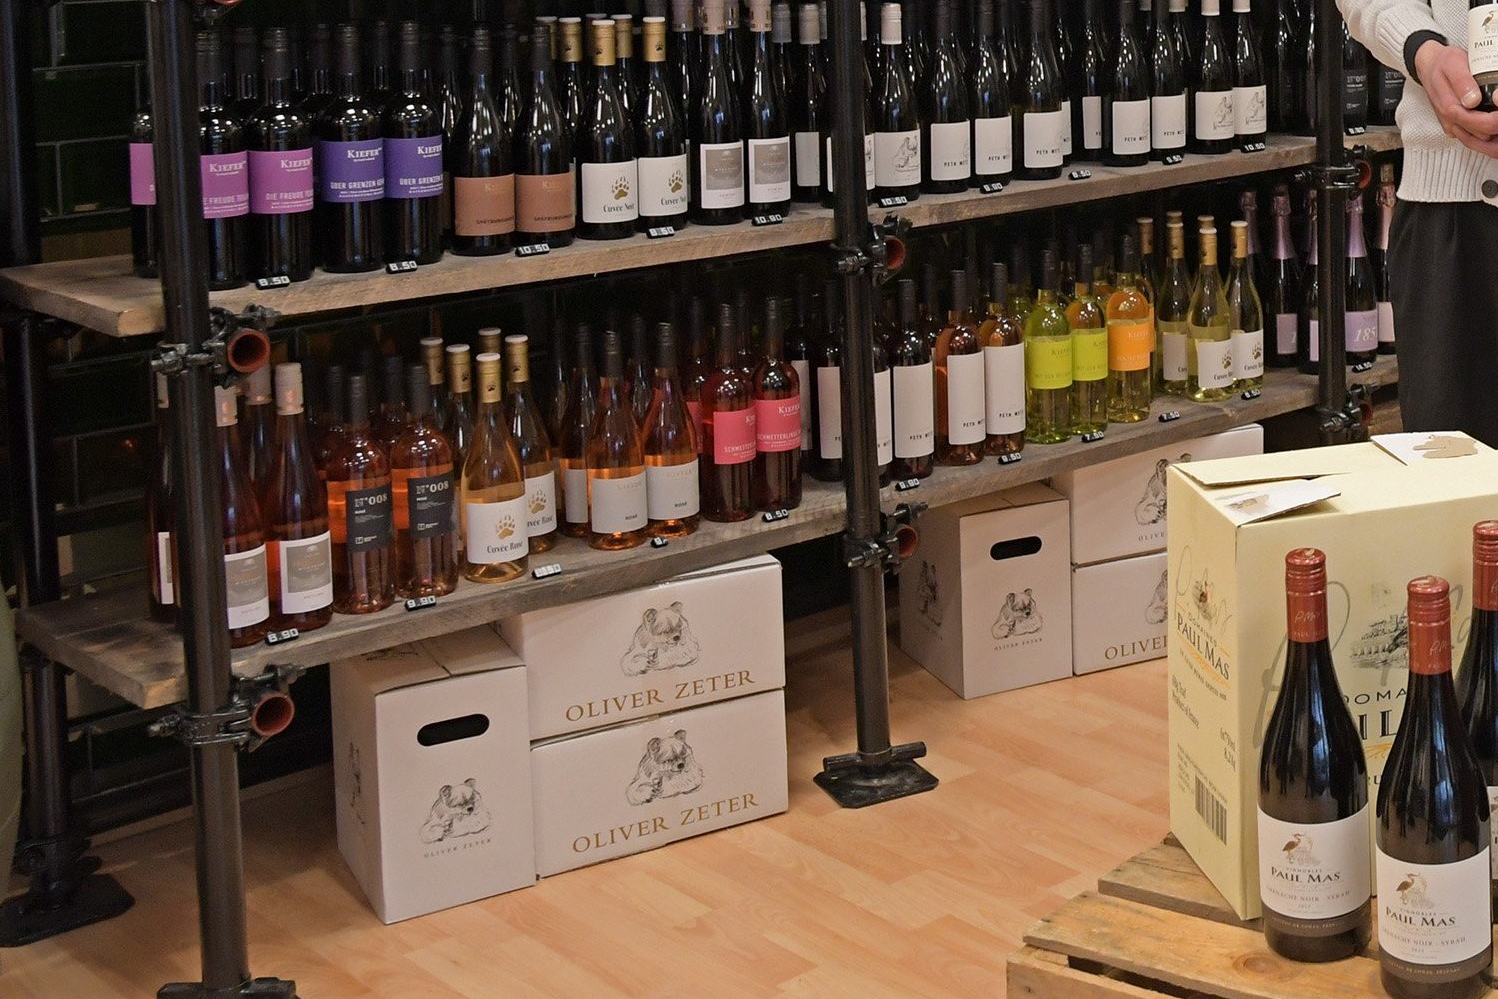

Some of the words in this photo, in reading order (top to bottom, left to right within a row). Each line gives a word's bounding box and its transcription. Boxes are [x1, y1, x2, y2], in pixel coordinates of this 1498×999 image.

[347, 148, 380, 159] KIEFER
[1138, 532, 1168, 542] OLIVE
[1177, 612, 1203, 654] PAUL
[1205, 641, 1230, 681] MAS
[565, 688, 665, 723] OLIVER
[675, 669, 756, 700] ZETER
[571, 817, 670, 854] OLIVER
[679, 792, 759, 824] ZETER
[423, 845, 459, 858] OLIVER
[463, 837, 493, 851] ZETER
[1271, 866, 1302, 883] PAUL
[1307, 871, 1341, 884] MAS
[1386, 906, 1417, 926] PAUL
[1421, 916, 1456, 927] MAS
